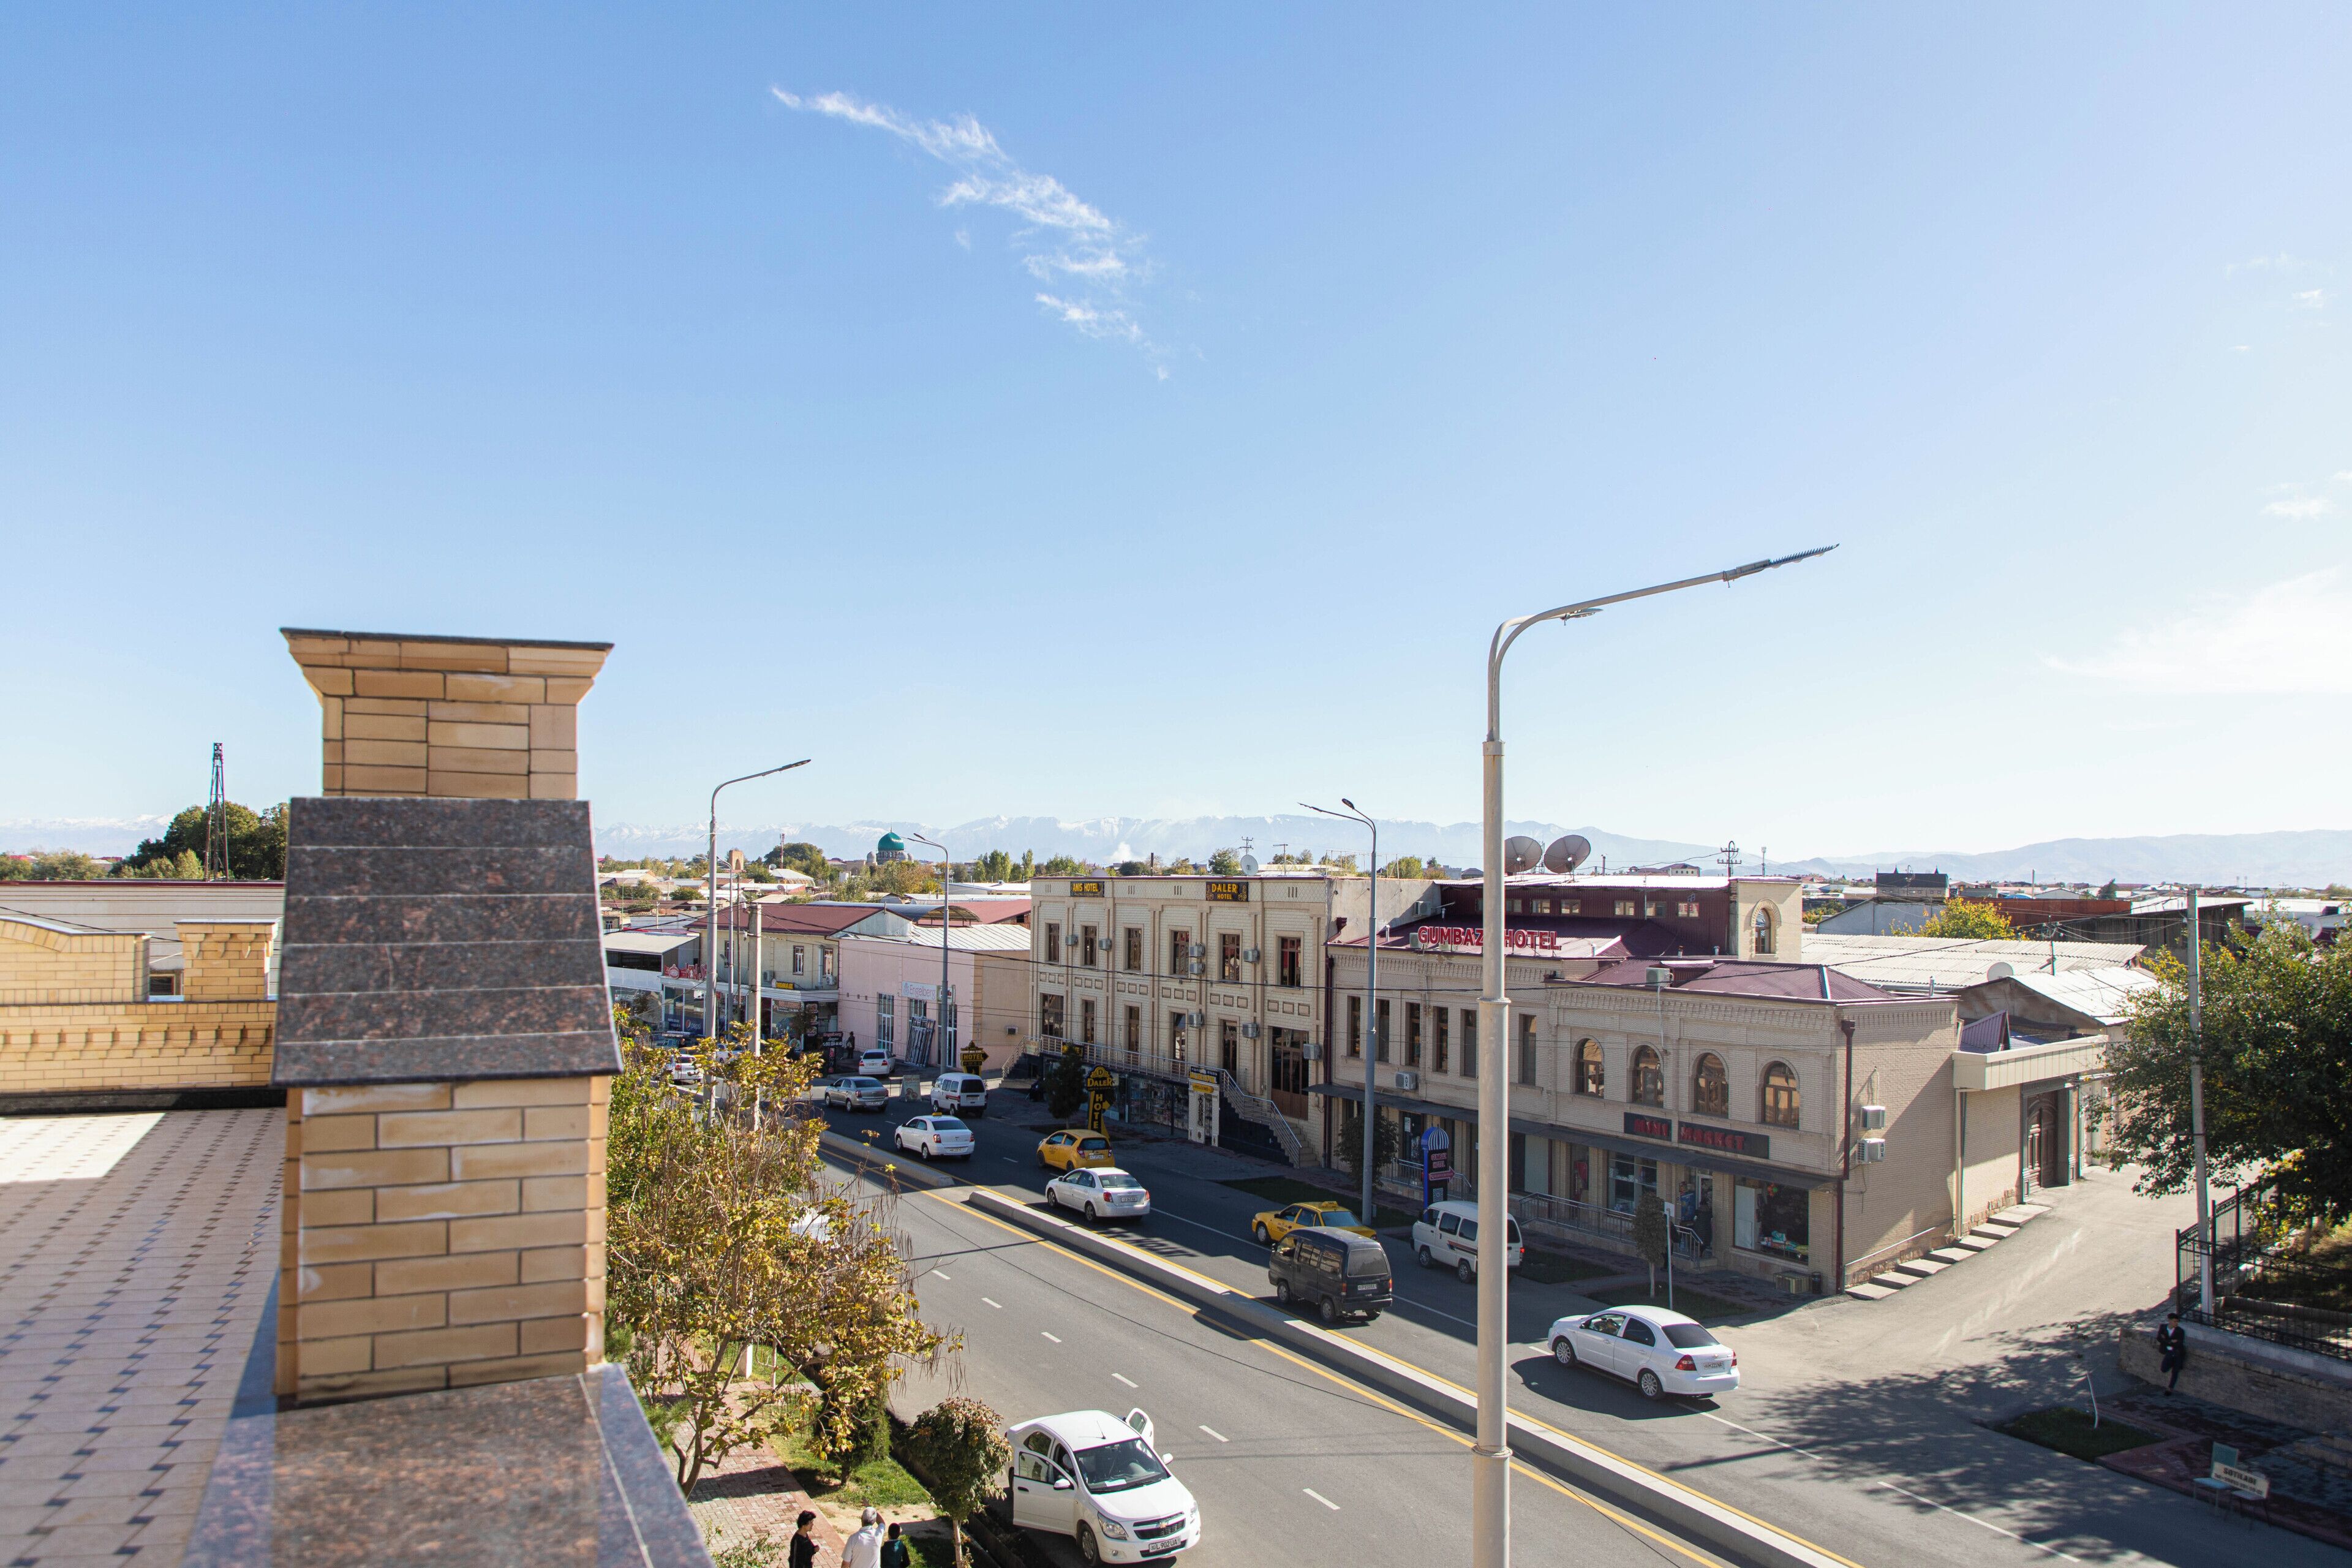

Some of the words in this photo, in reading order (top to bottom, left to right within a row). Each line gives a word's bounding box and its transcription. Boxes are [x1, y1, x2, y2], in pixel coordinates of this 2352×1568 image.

[1212, 884, 1237, 893] DALER
[1417, 926, 1483, 946] GUMBAZ
[1504, 929, 1562, 950] HOTEL
[910, 984, 936, 1000] Engelberg
[1087, 1078, 1112, 1087] DALER
[1093, 1094, 1102, 1128] HOTE
[1634, 1119, 1668, 1137] MINI
[1681, 1127, 1744, 1150] MARKET
